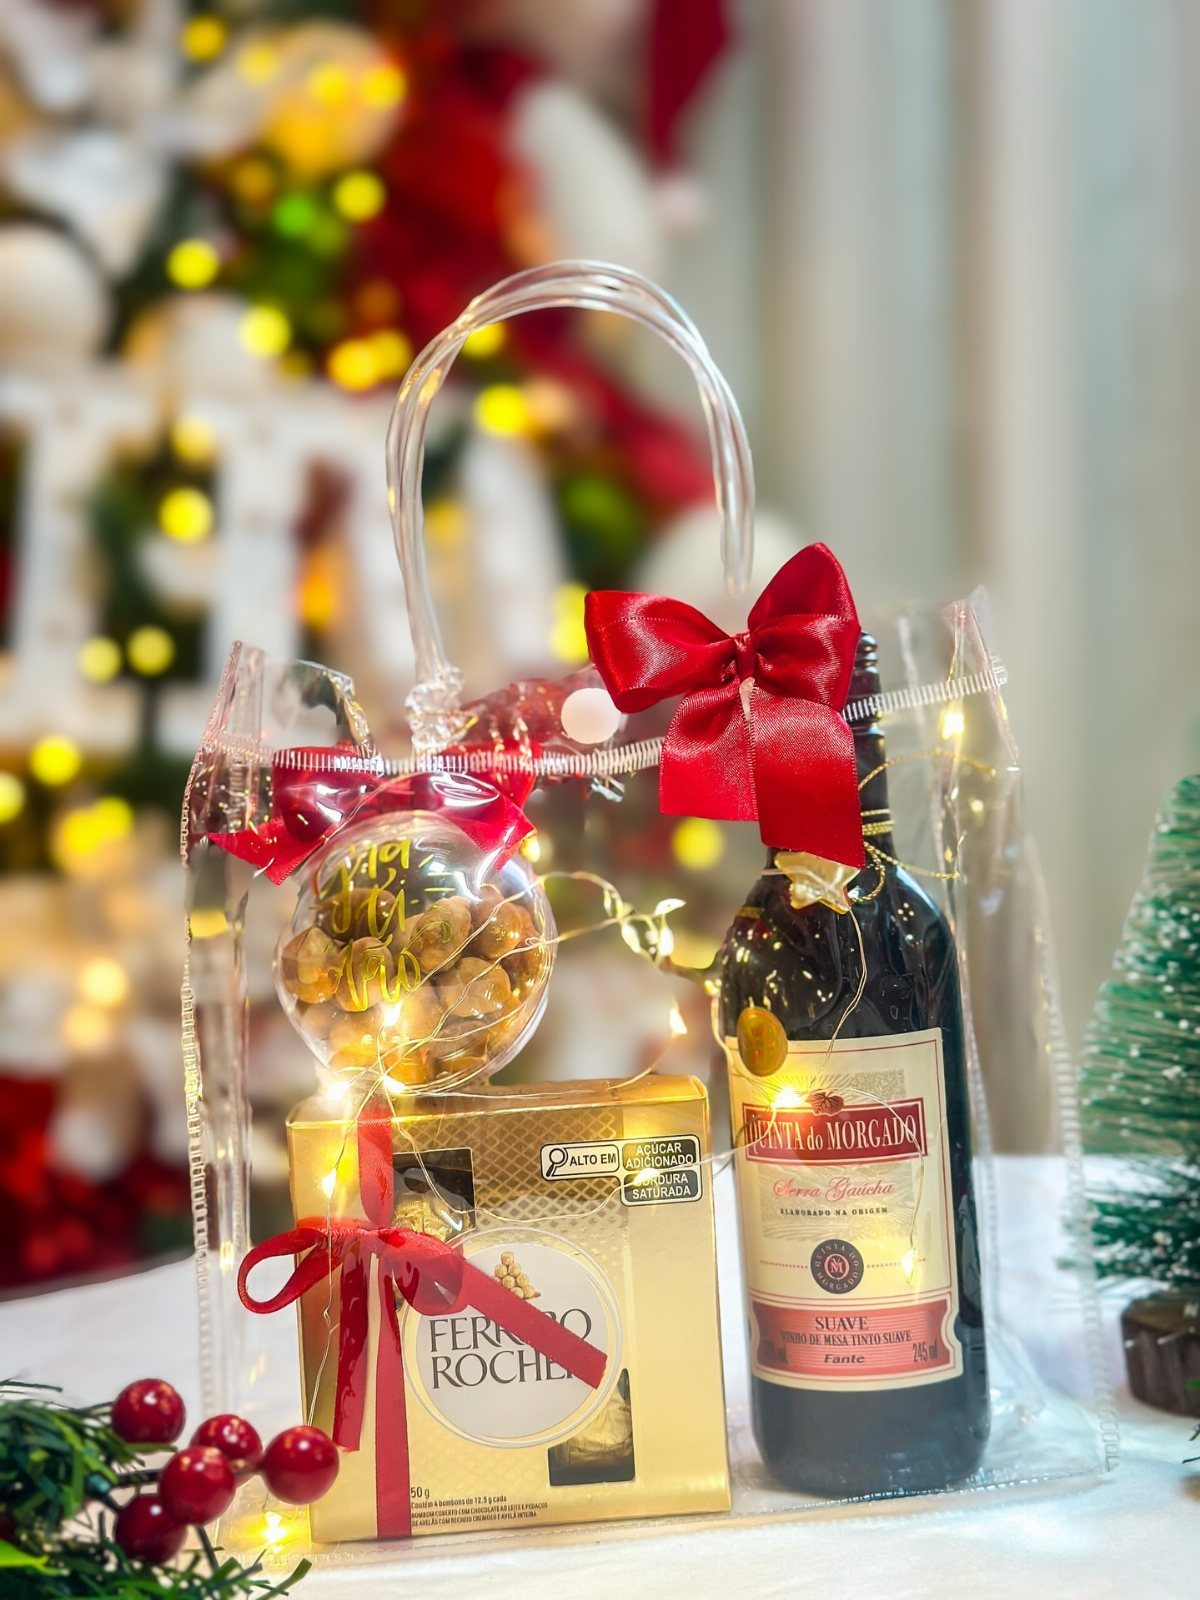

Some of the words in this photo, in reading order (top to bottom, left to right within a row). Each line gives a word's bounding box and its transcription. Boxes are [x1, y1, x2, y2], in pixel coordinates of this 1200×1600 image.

[749, 1118, 804, 1154] QUINTA
[806, 1126, 824, 1151] do
[826, 1114, 917, 1150] MORGADO
[636, 1141, 682, 1157] AÇÚCAR
[569, 1154, 598, 1167] ALTO
[600, 1153, 617, 1164] EM
[625, 1153, 694, 1169] ADICIONADO
[632, 1185, 691, 1199] SATURADA
[773, 1178, 821, 1197] Serra
[825, 1176, 895, 1203] Gaúcha
[780, 1208, 831, 1216] ELABORADO
[852, 1207, 888, 1216] ORIGEM
[815, 1316, 869, 1331] SUAVE
[781, 1331, 808, 1345] VINHO
[809, 1333, 821, 1346] DE
[823, 1334, 849, 1347] MESA
[850, 1333, 881, 1346] TINTO
[883, 1330, 912, 1344] SUAVE
[823, 1353, 866, 1364] Fante
[912, 1342, 928, 1362] 245
[410, 1486, 423, 1498] 50
[424, 1489, 430, 1499] g
[411, 1499, 434, 1509] Contém
[438, 1498, 465, 1507] bombons
[466, 1497, 473, 1505] de
[493, 1494, 507, 1503] cada
